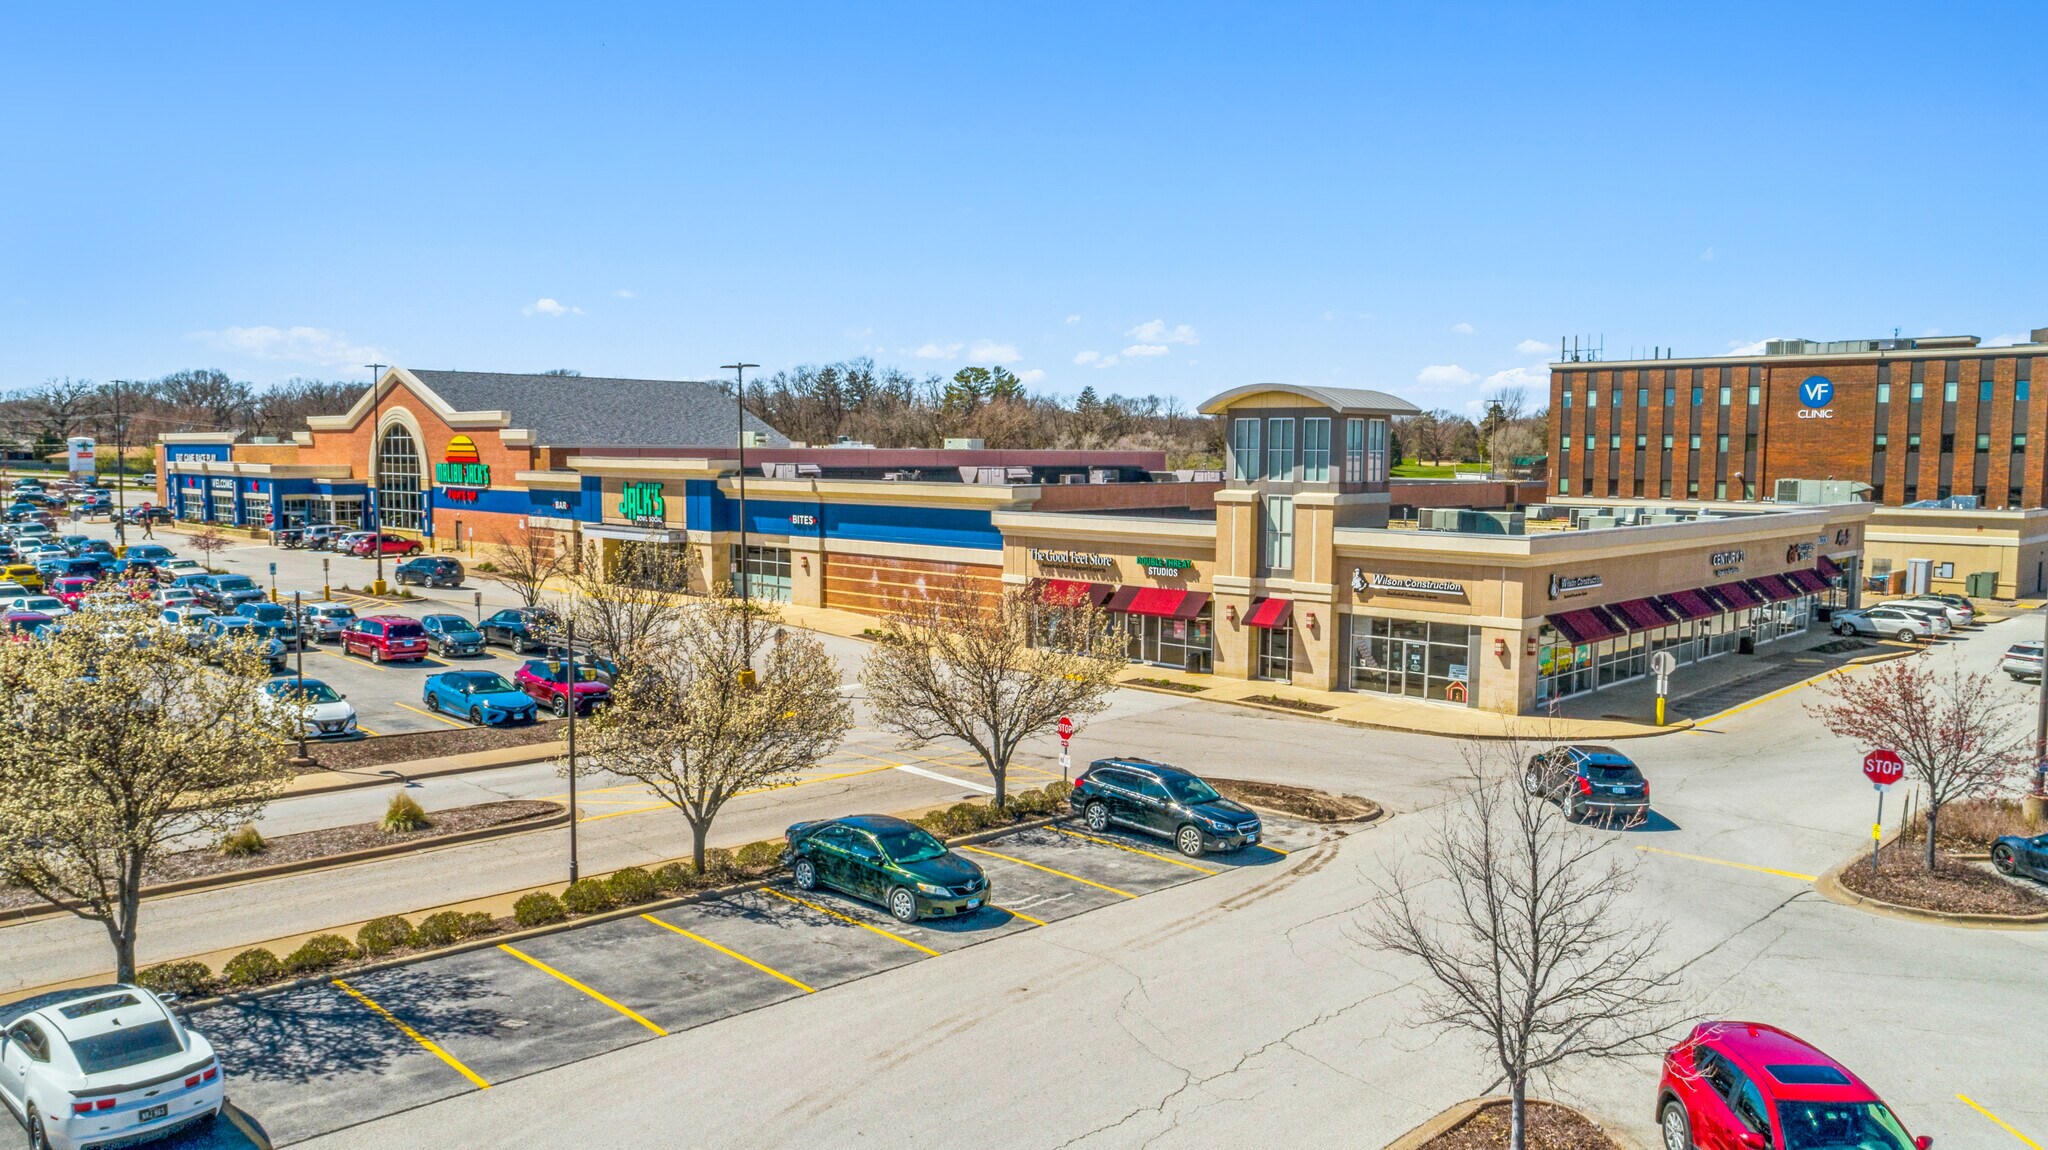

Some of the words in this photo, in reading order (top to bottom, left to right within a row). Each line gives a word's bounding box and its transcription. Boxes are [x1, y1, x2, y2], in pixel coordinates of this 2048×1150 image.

[1805, 383, 1829, 401] VF
[1797, 409, 1834, 419] CLINIC
[436, 462, 463, 483] MALIBU
[464, 463, 490, 485] JACK'S
[211, 478, 234, 489] WELCOME
[554, 501, 568, 510] BAR
[618, 481, 665, 520] JACK'S
[792, 514, 814, 525] BITES
[1029, 548, 1045, 561] The
[1045, 549, 1069, 563] Good
[1071, 551, 1089, 565] Feet
[1089, 553, 1112, 566] Store
[1136, 556, 1163, 567] DOUBLE
[1164, 558, 1192, 569] THREAT
[1072, 565, 1089, 573] Support
[1148, 566, 1178, 577] STUDIOS
[1372, 573, 1403, 587] Wilson
[1404, 578, 1462, 591] Construction
[1057, 723, 1073, 734] STOP
[1865, 759, 1902, 776] STOP
